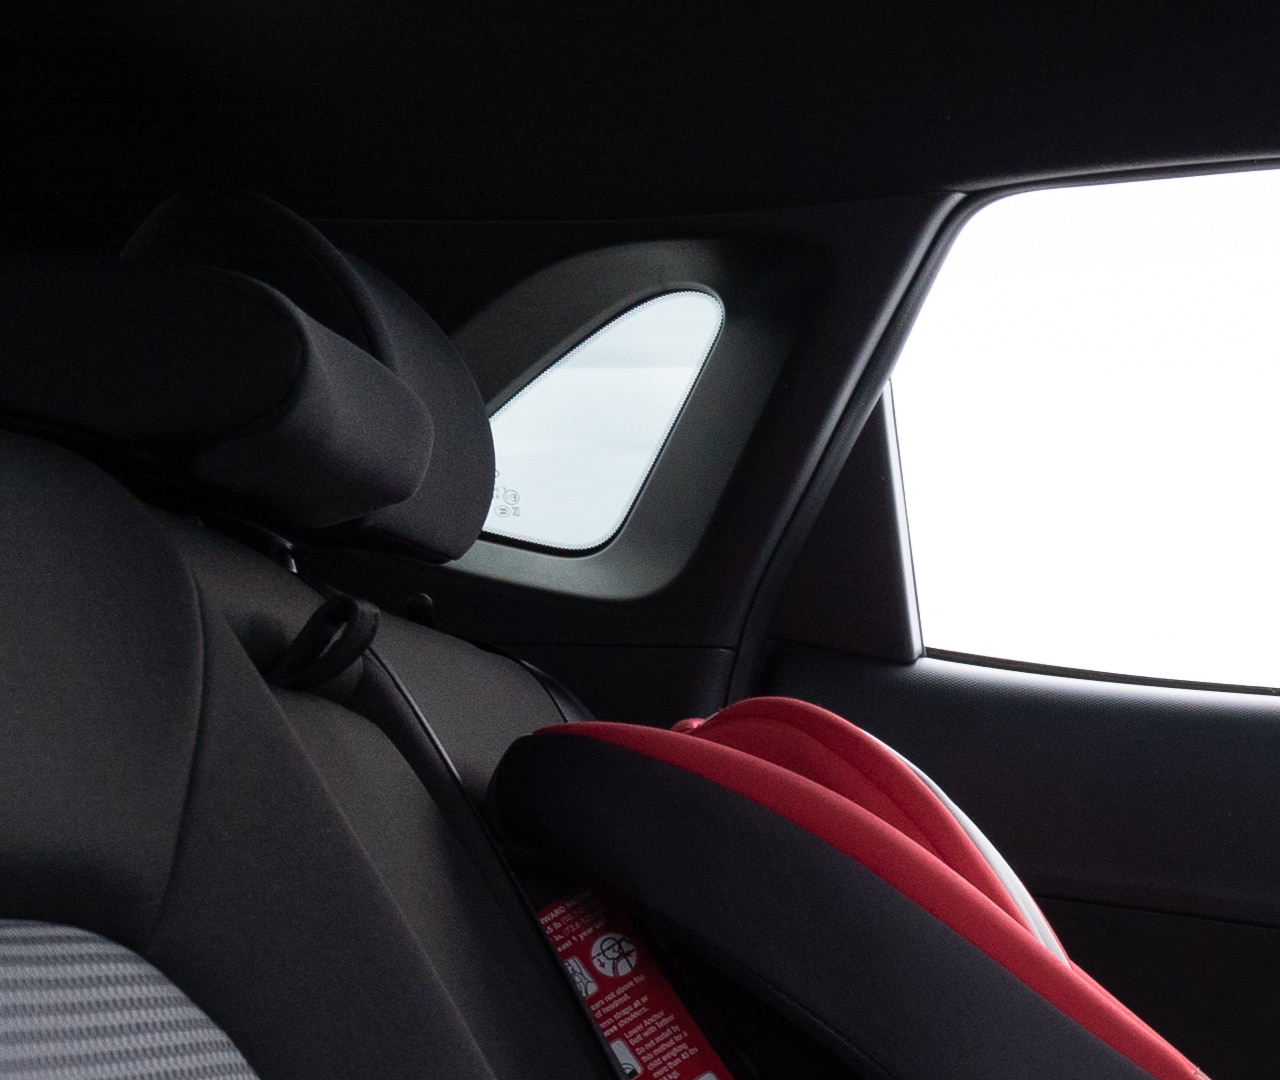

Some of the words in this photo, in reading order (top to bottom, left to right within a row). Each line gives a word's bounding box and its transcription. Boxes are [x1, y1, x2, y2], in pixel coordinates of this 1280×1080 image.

[556, 939, 573, 952] east
[603, 991, 616, 1002] not
[614, 979, 635, 995] above
[633, 972, 646, 984] top
[594, 1010, 603, 1019] of
[612, 1004, 634, 1021] straps
[631, 999, 641, 1008] at
[623, 1022, 644, 1039] Lower
[642, 1008, 665, 1026] Anchor
[628, 1033, 643, 1046] Belt
[641, 1024, 657, 1038] with
[655, 1012, 675, 1028] Tether
[635, 1045, 646, 1055] Do
[643, 1038, 656, 1050] not
[670, 1023, 681, 1033] by
[641, 1051, 654, 1063] this
[651, 1037, 675, 1055] method
[673, 1032, 683, 1041] for
[646, 1057, 662, 1071] child
[660, 1041, 689, 1063] weighing
[652, 1065, 669, 1078] more
[667, 1056, 681, 1068] than
